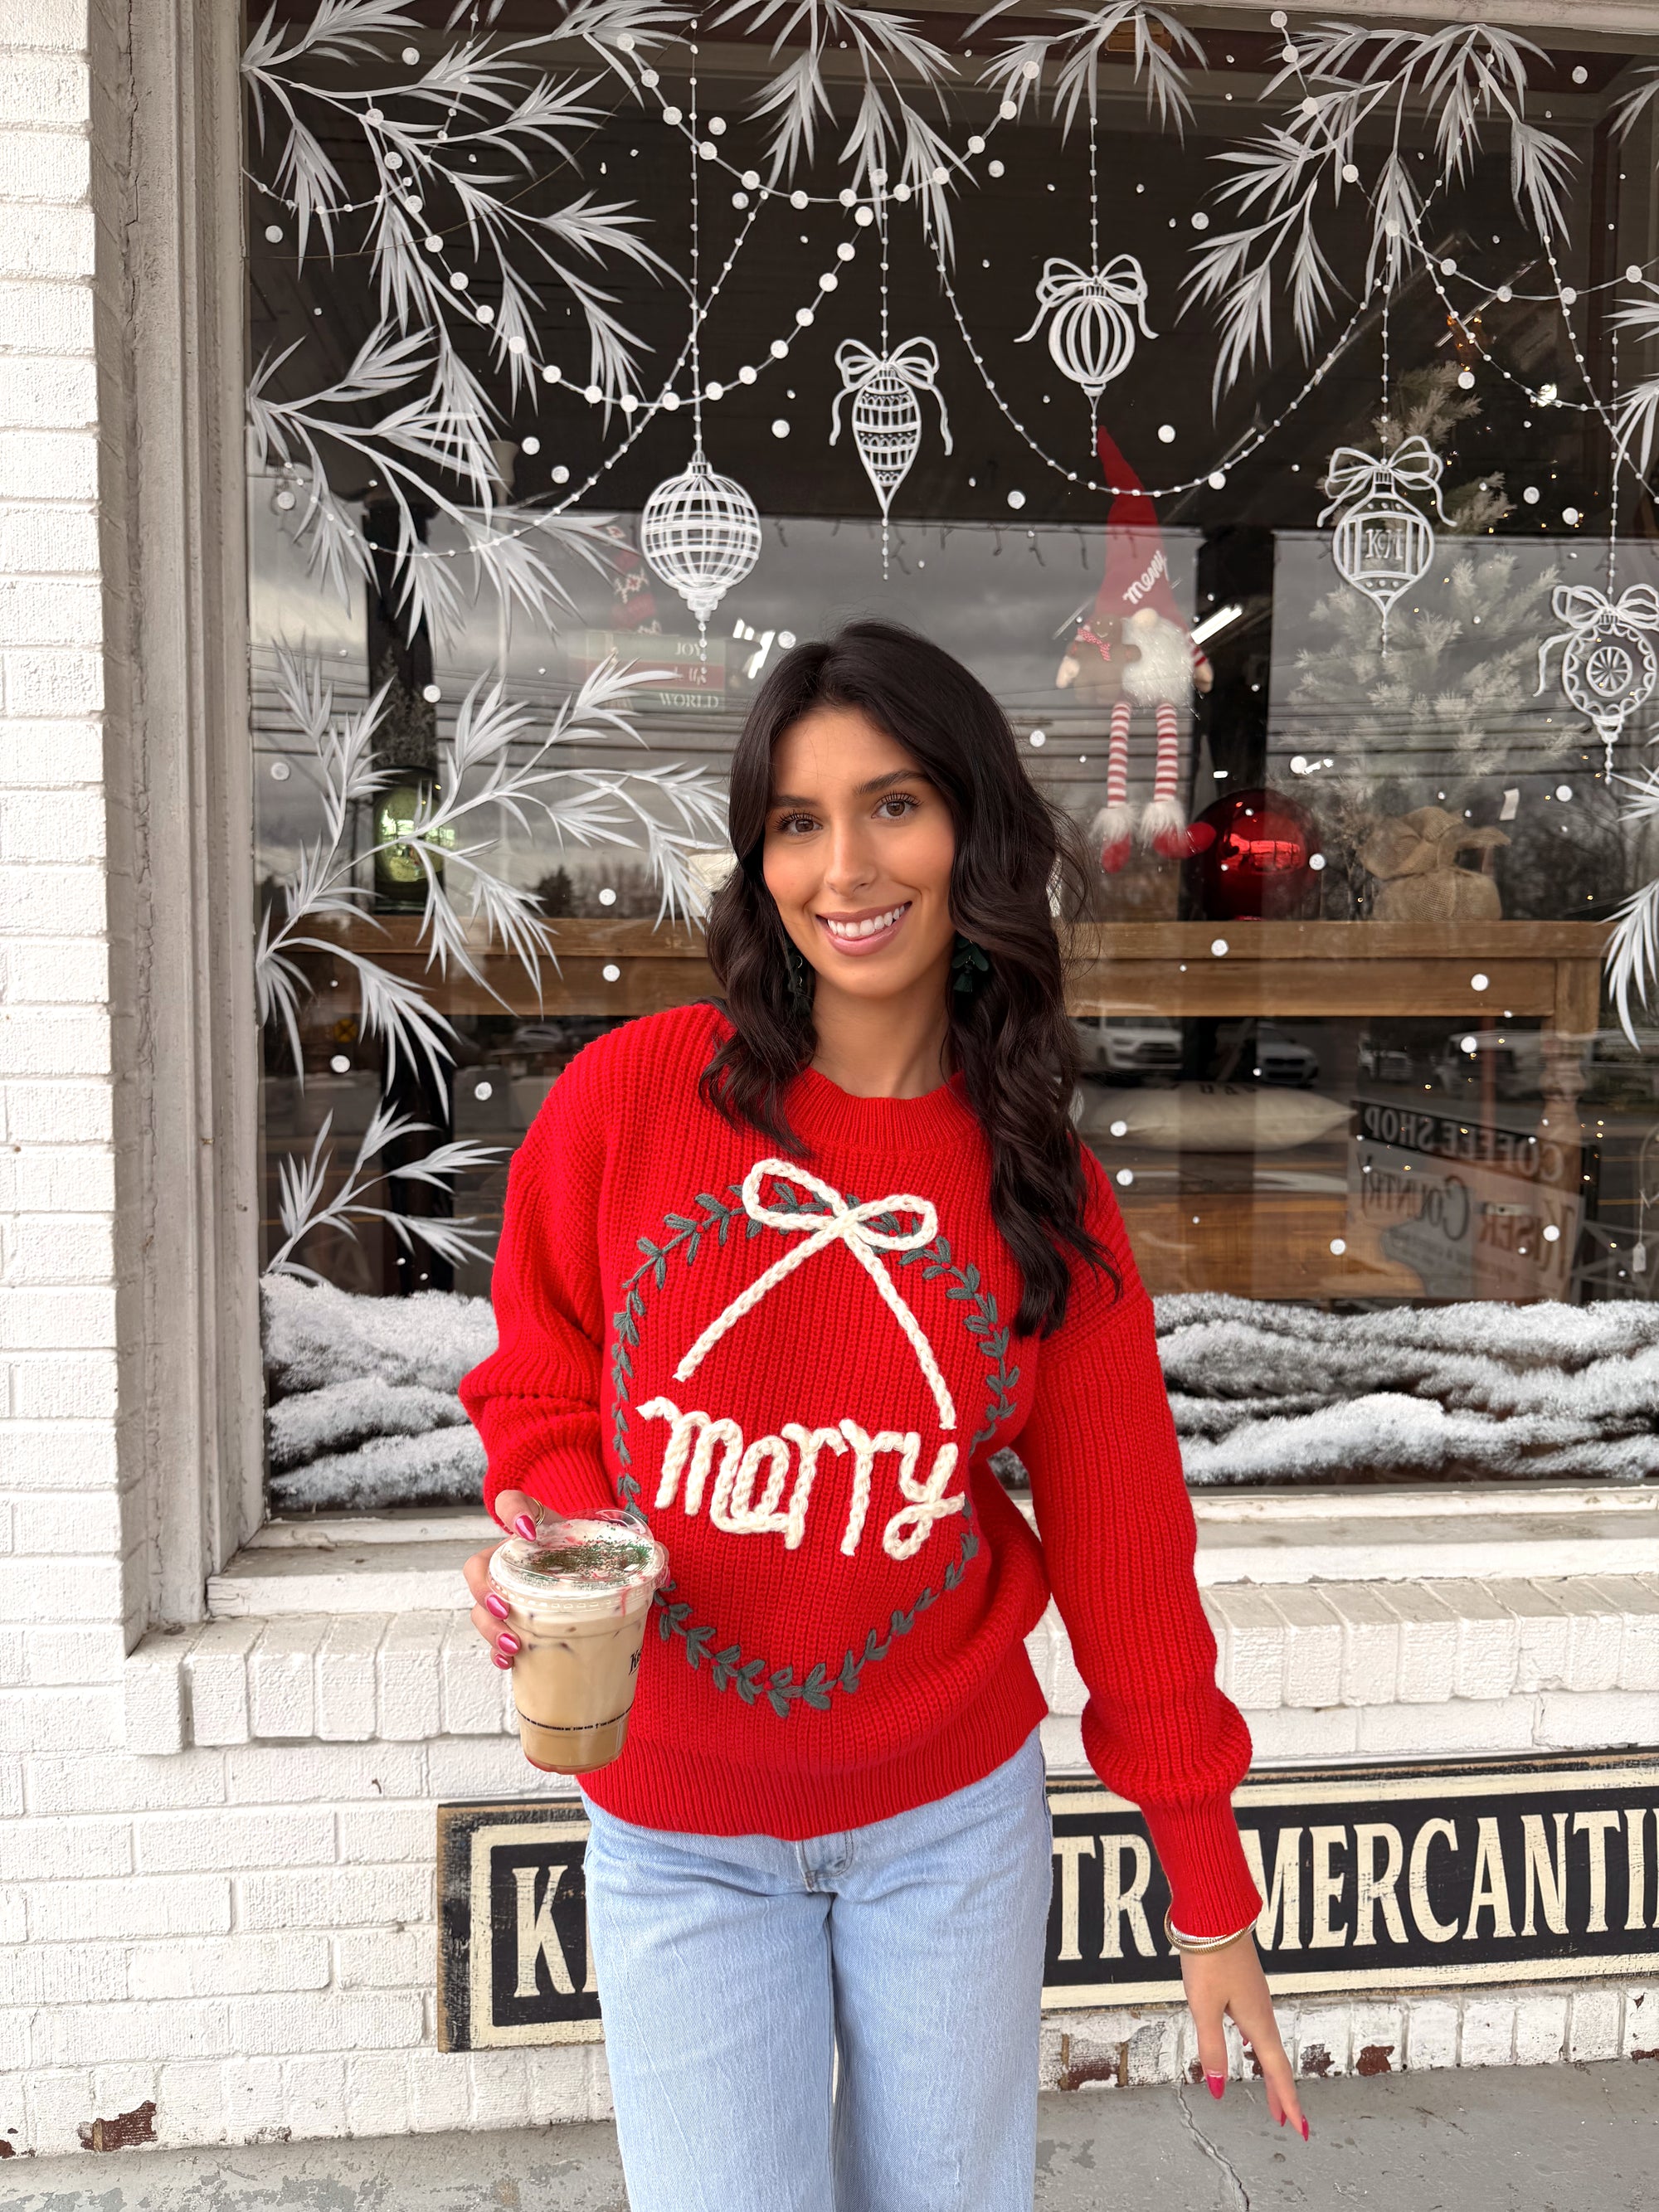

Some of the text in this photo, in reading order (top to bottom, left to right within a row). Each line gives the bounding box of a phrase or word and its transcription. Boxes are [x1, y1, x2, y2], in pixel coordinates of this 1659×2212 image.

[674, 642, 703, 657] JOY
[659, 693, 719, 708] WORLD
[1238, 1808, 1659, 1951] MERCANTI
